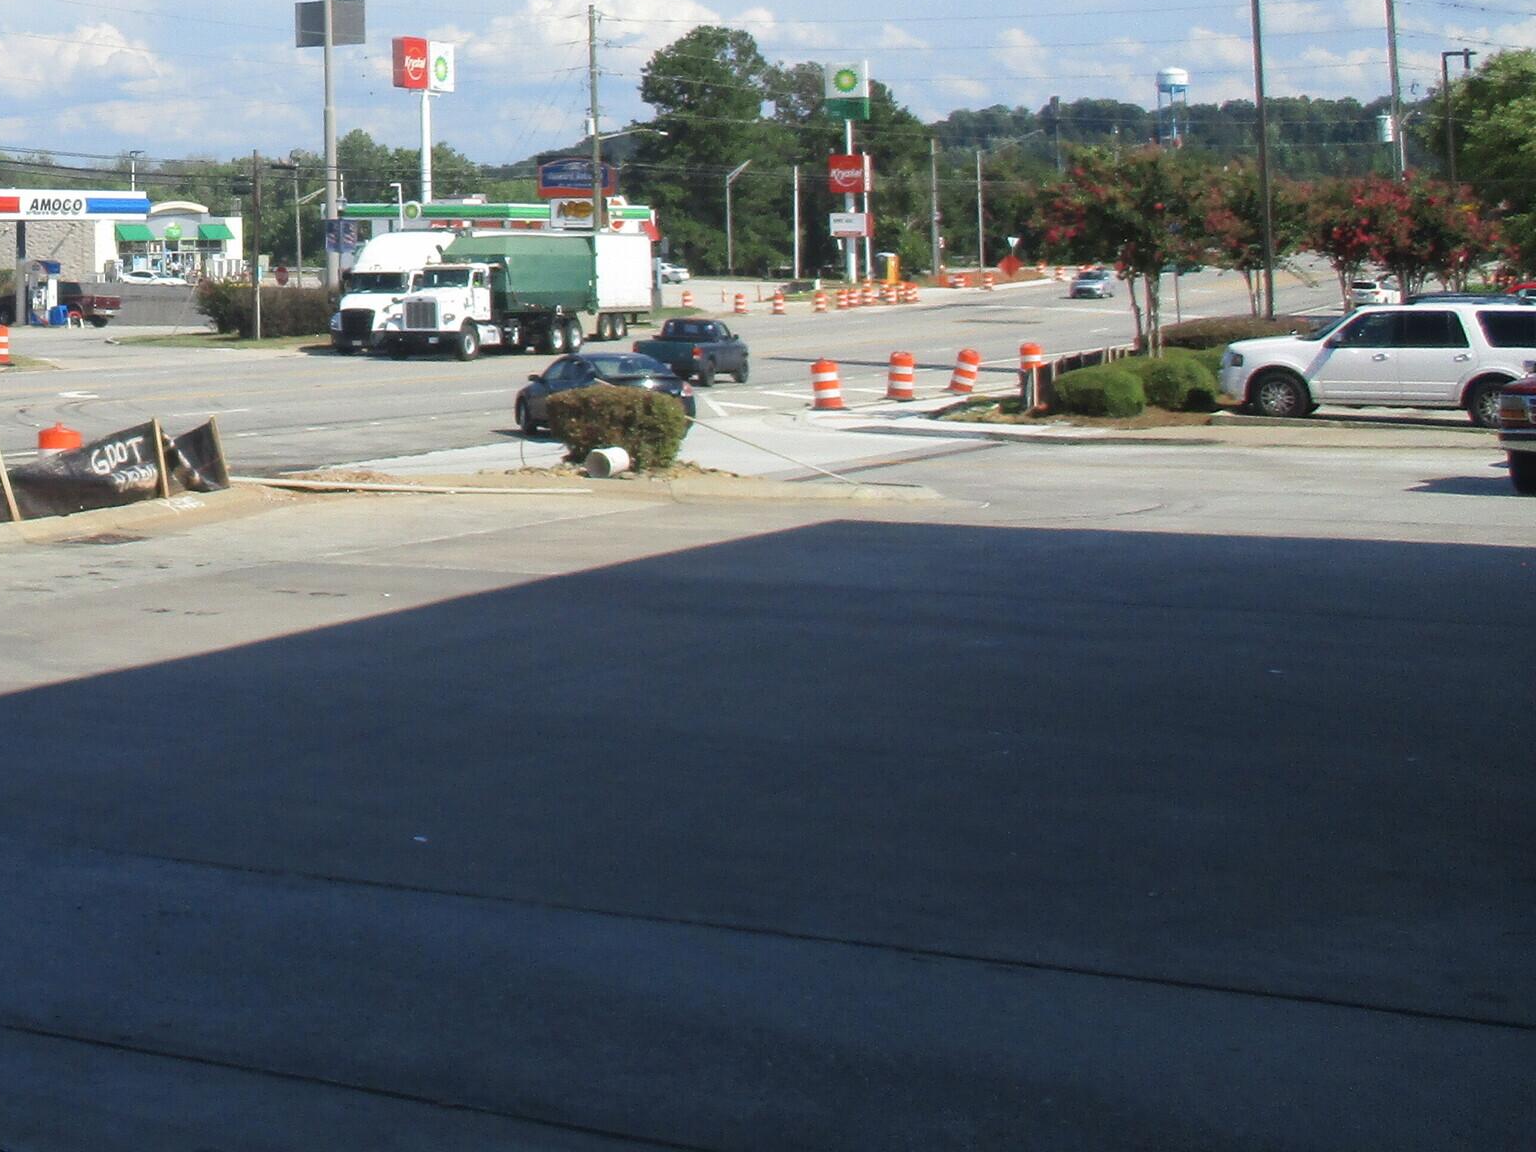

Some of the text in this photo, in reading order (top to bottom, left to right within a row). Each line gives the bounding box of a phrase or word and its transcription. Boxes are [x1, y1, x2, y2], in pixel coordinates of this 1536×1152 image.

[830, 168, 862, 180] Krystal
[29, 198, 83, 212] AMOCO
[91, 435, 145, 476] GDOT
